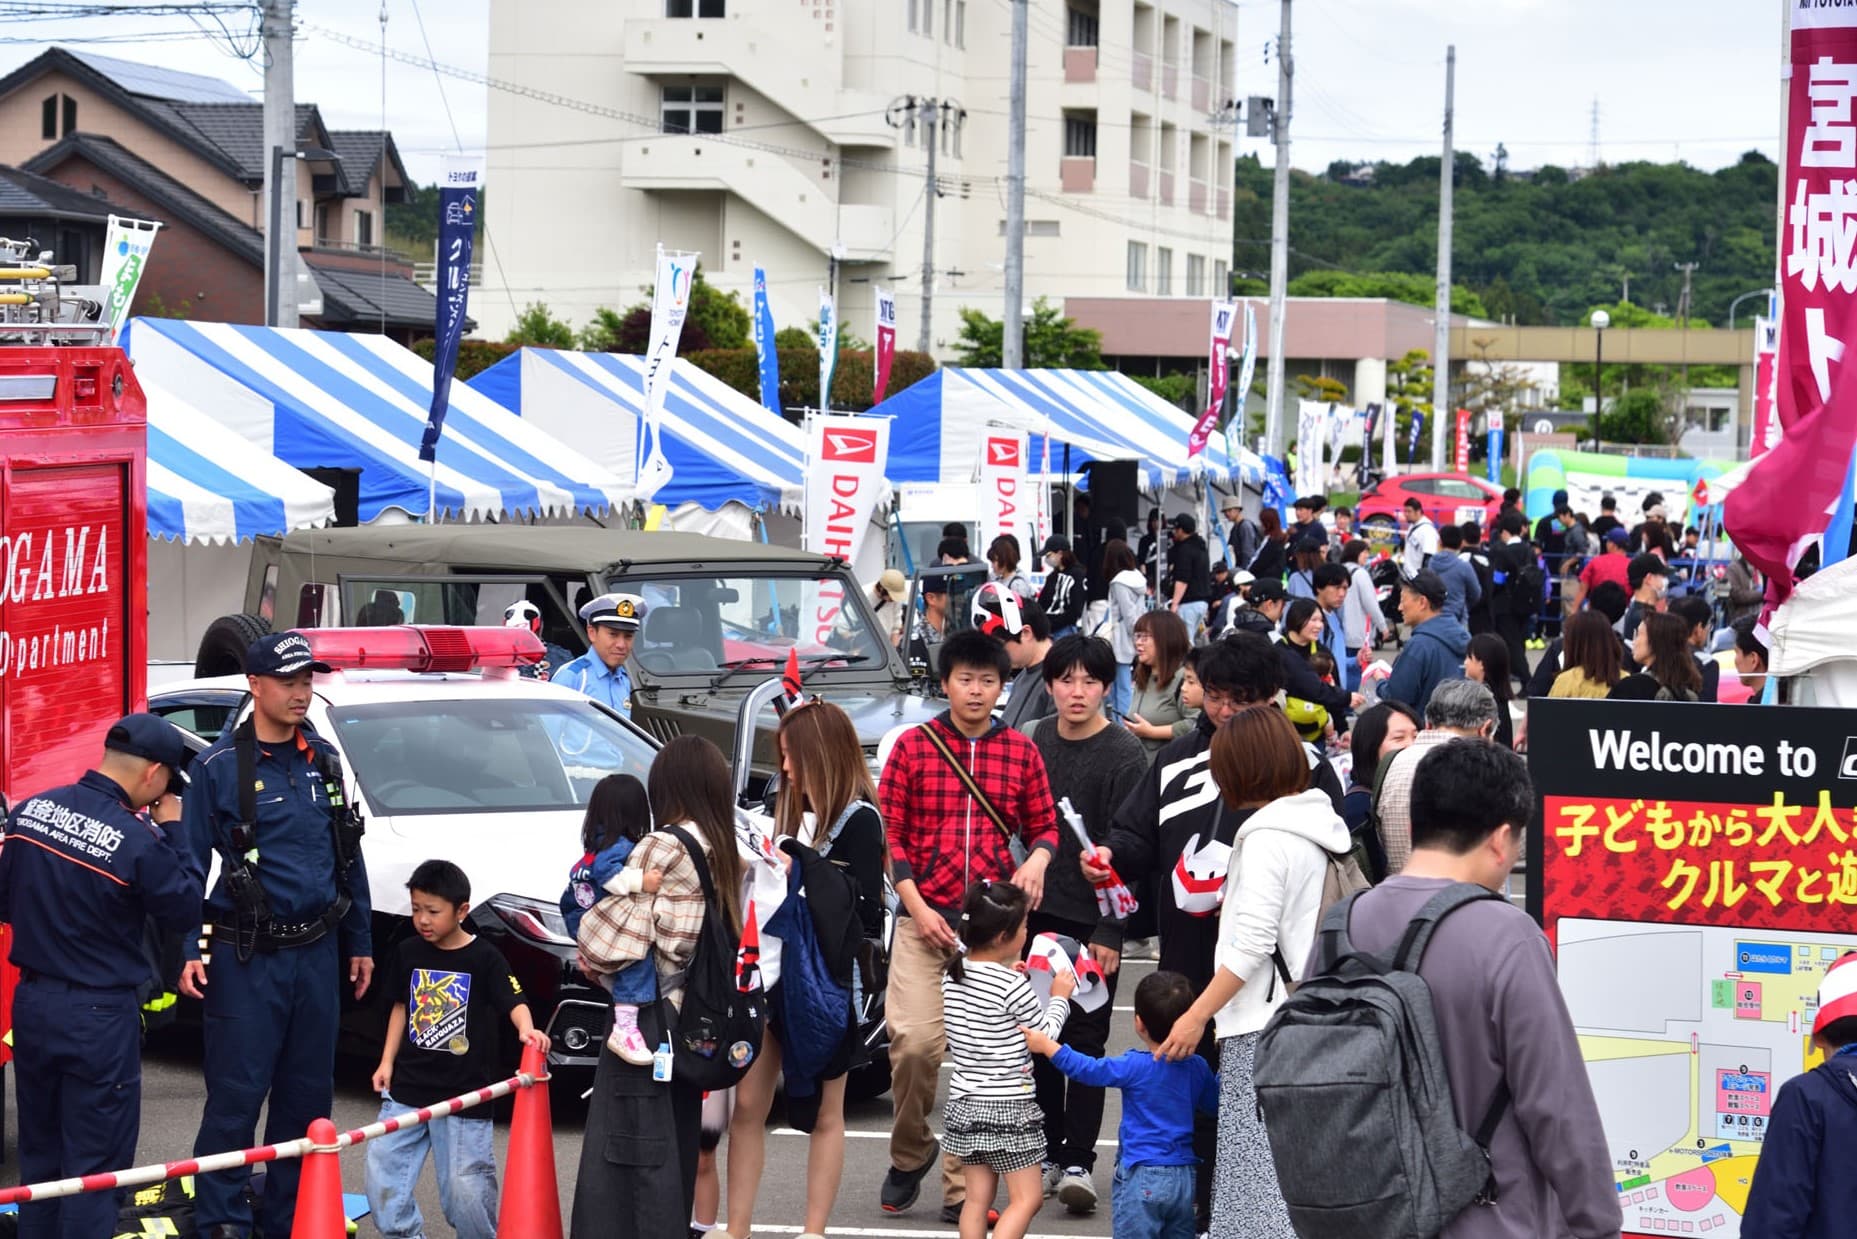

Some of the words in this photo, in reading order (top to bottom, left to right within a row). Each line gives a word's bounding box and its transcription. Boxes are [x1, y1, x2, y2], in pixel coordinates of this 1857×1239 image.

[1589, 729, 1764, 775] Welcome
[1777, 740, 1816, 777] to
[1556, 790, 1857, 856] 子どもから大人
[49, 829, 69, 845] AREA
[69, 837, 86, 851] FIRE
[86, 845, 112, 863] DEPT.
[425, 1017, 464, 1048] RAYQUAZA
